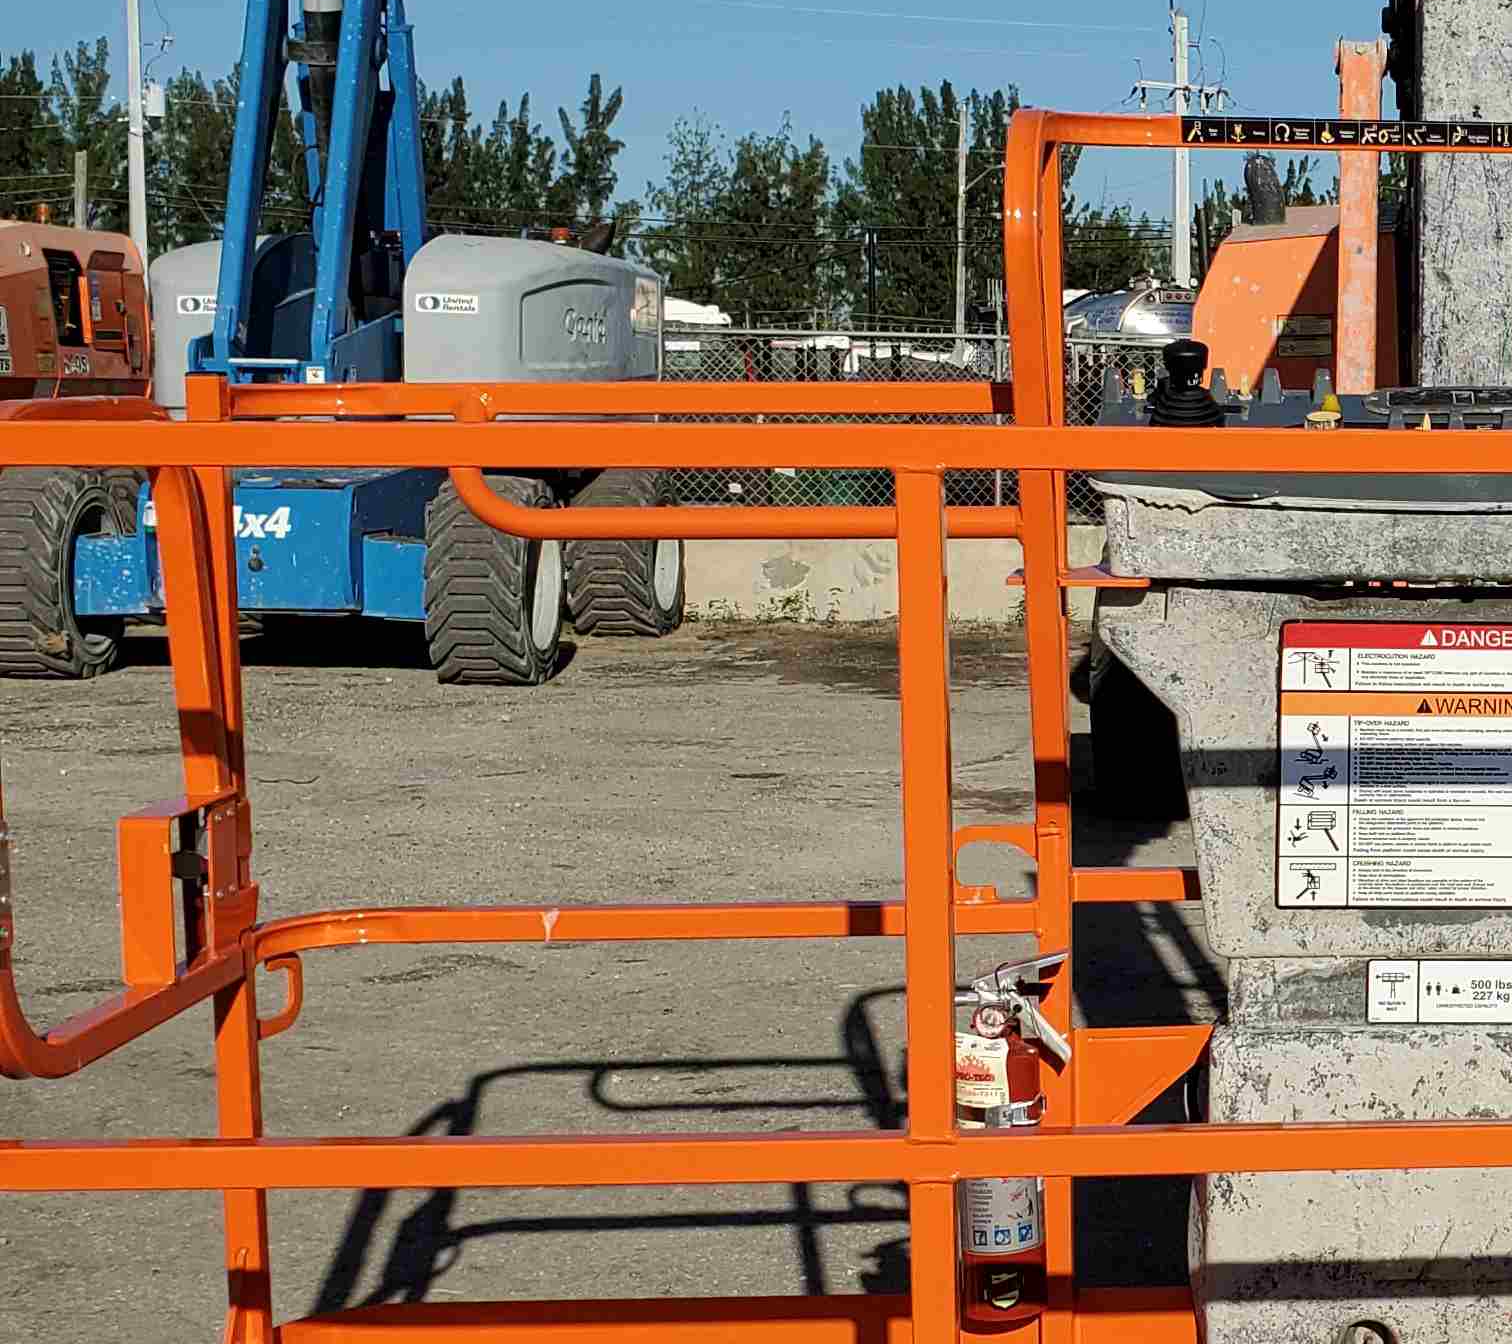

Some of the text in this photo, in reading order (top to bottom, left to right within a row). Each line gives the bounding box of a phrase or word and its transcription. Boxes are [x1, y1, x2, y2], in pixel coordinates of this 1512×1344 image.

[443, 296, 474, 305] United
[443, 304, 476, 313] Rentals
[1470, 979, 1512, 990] 500 lbs
[1472, 991, 1510, 1003] 227 kg
